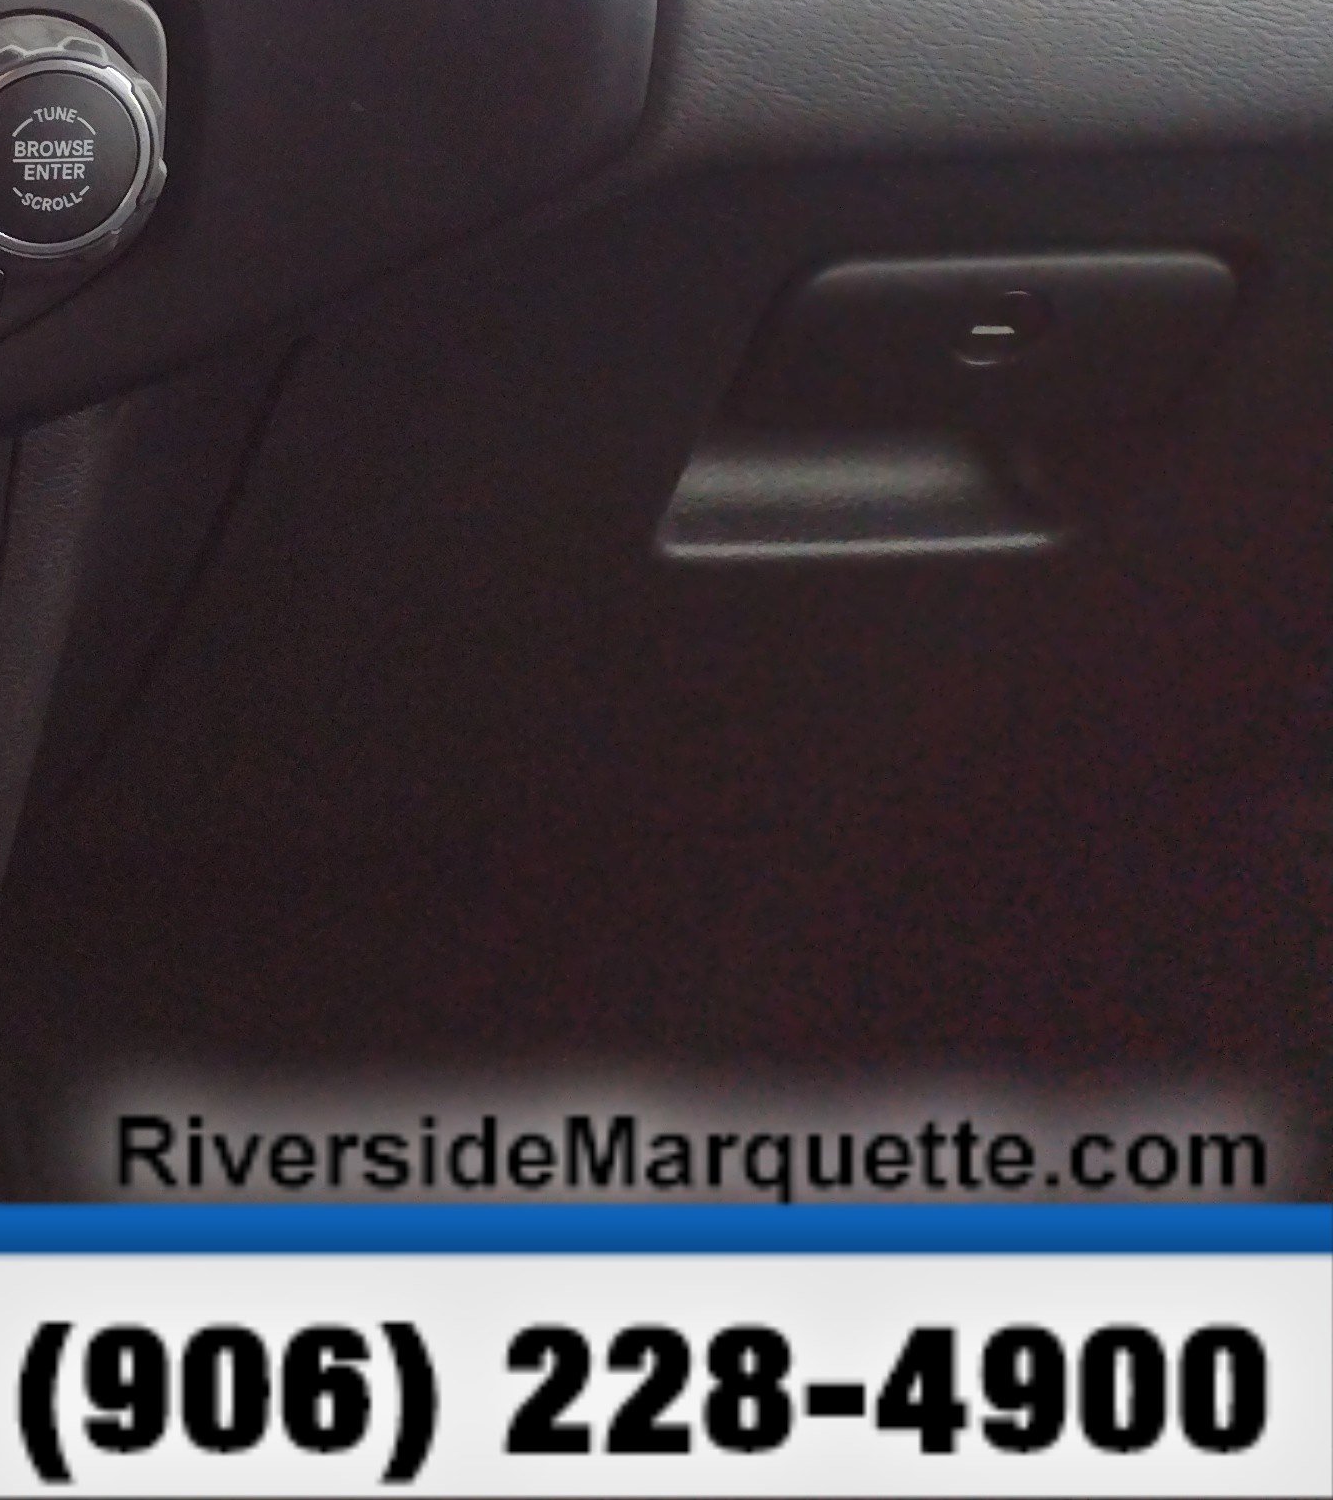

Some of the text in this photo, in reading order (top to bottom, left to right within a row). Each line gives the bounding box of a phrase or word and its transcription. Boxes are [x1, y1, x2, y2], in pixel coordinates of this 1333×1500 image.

[34, 105, 78, 125] TUNE
[13, 139, 94, 158] BROWSE
[23, 162, 85, 181] ENTER
[21, 191, 83, 212] SCROLL
